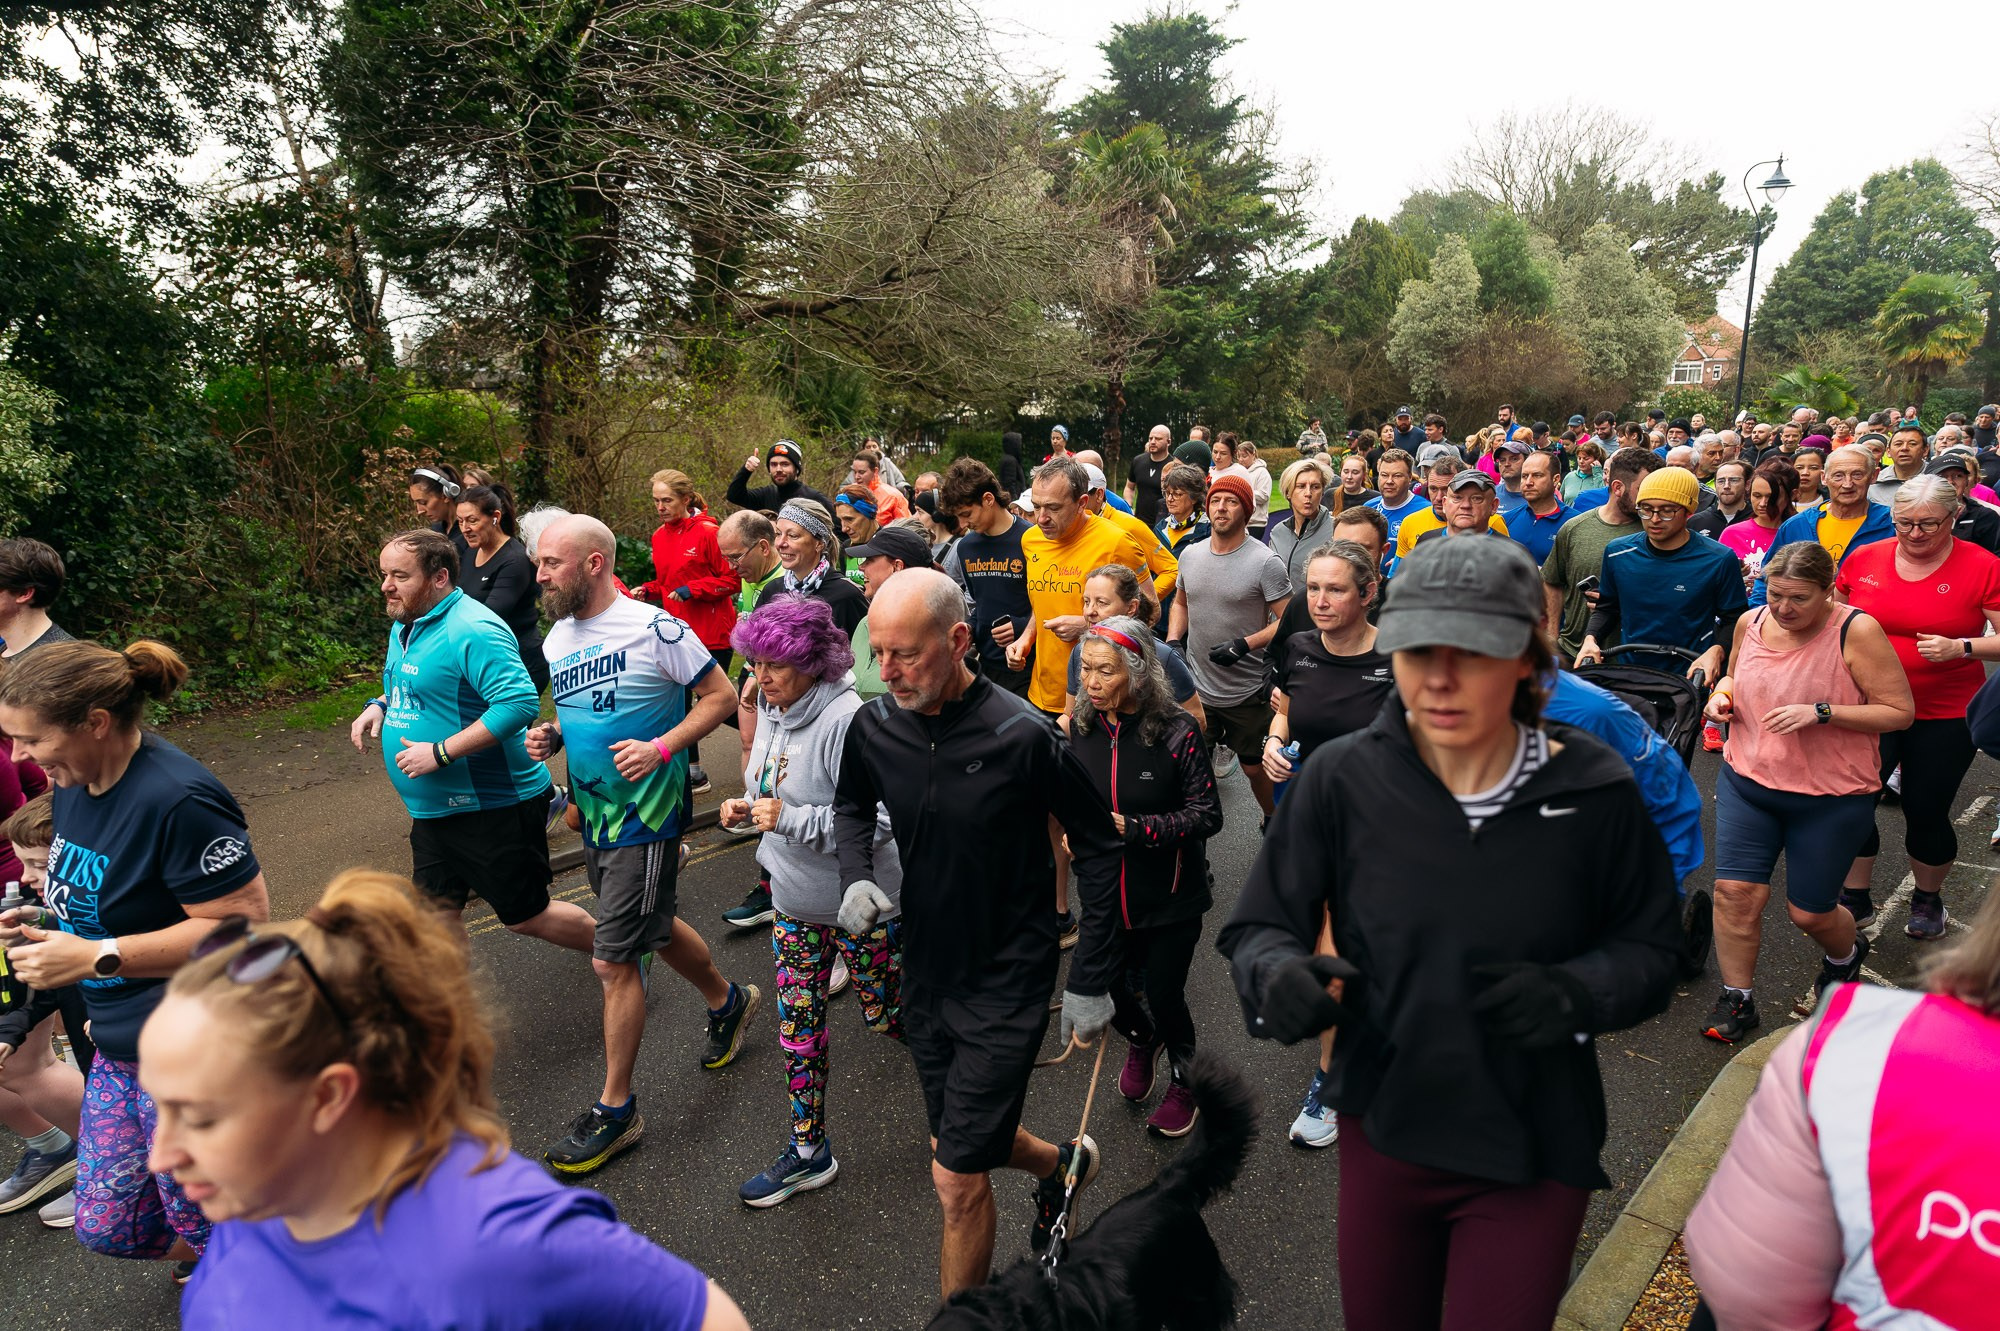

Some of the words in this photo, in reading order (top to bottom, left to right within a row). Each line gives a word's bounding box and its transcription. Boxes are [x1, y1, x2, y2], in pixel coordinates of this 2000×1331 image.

[965, 557, 1009, 572] Timberland
[1058, 565, 1083, 578] Vitality
[1421, 559, 1485, 591] LA
[1859, 575, 1879, 587] parkrun
[1029, 572, 1082, 594] parkrun
[1296, 656, 1318, 669] parkrun
[552, 650, 627, 698] ARATHON
[592, 690, 616, 713] 24
[398, 711, 419, 721] Metric
[786, 744, 803, 756] TEAM
